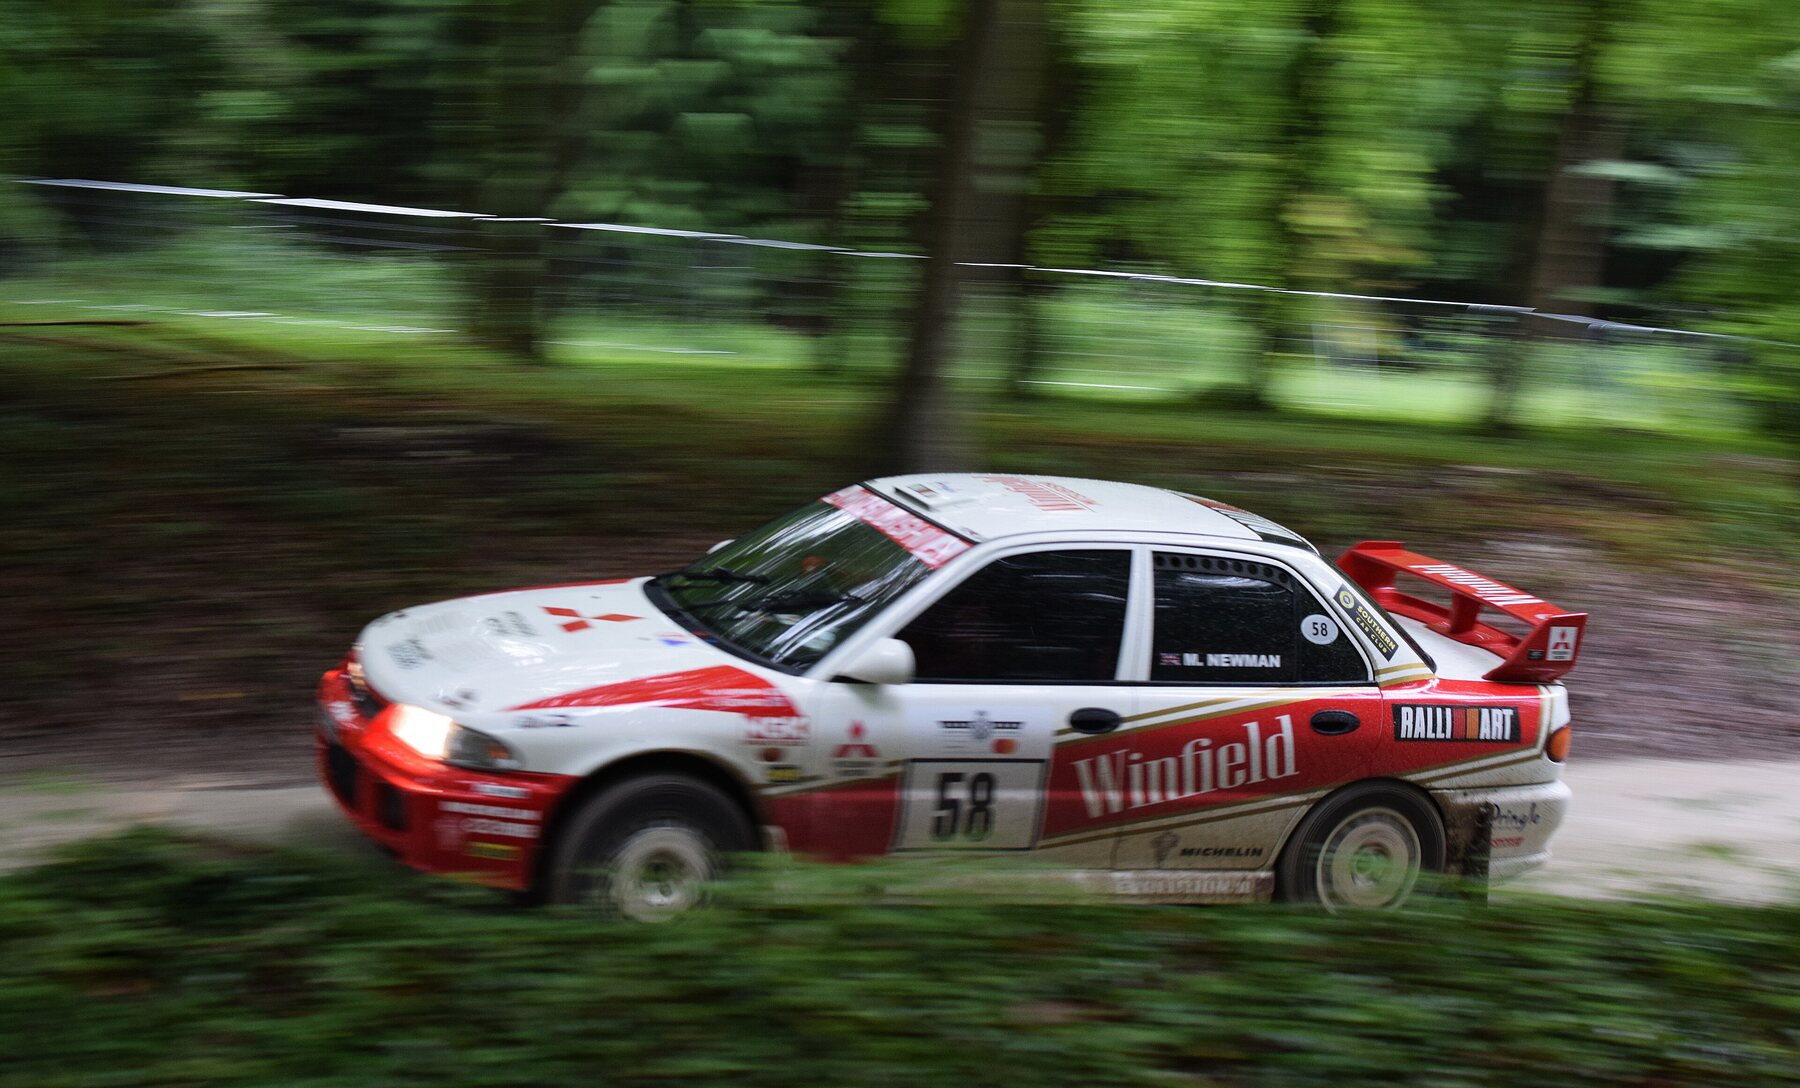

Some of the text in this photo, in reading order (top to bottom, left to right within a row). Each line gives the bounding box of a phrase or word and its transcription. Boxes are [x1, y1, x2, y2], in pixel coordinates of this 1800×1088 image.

[1312, 621, 1328, 637] 58
[1356, 617, 1388, 654] CAR CLUB
[1357, 605, 1397, 650] SOUTHERN
[1182, 653, 1281, 668] M. NEWMAN
[1400, 706, 1514, 741] RALLI ART
[1071, 714, 1300, 819] Winfield
[931, 772, 995, 842] 58
[1180, 847, 1264, 858] MICHELIN
